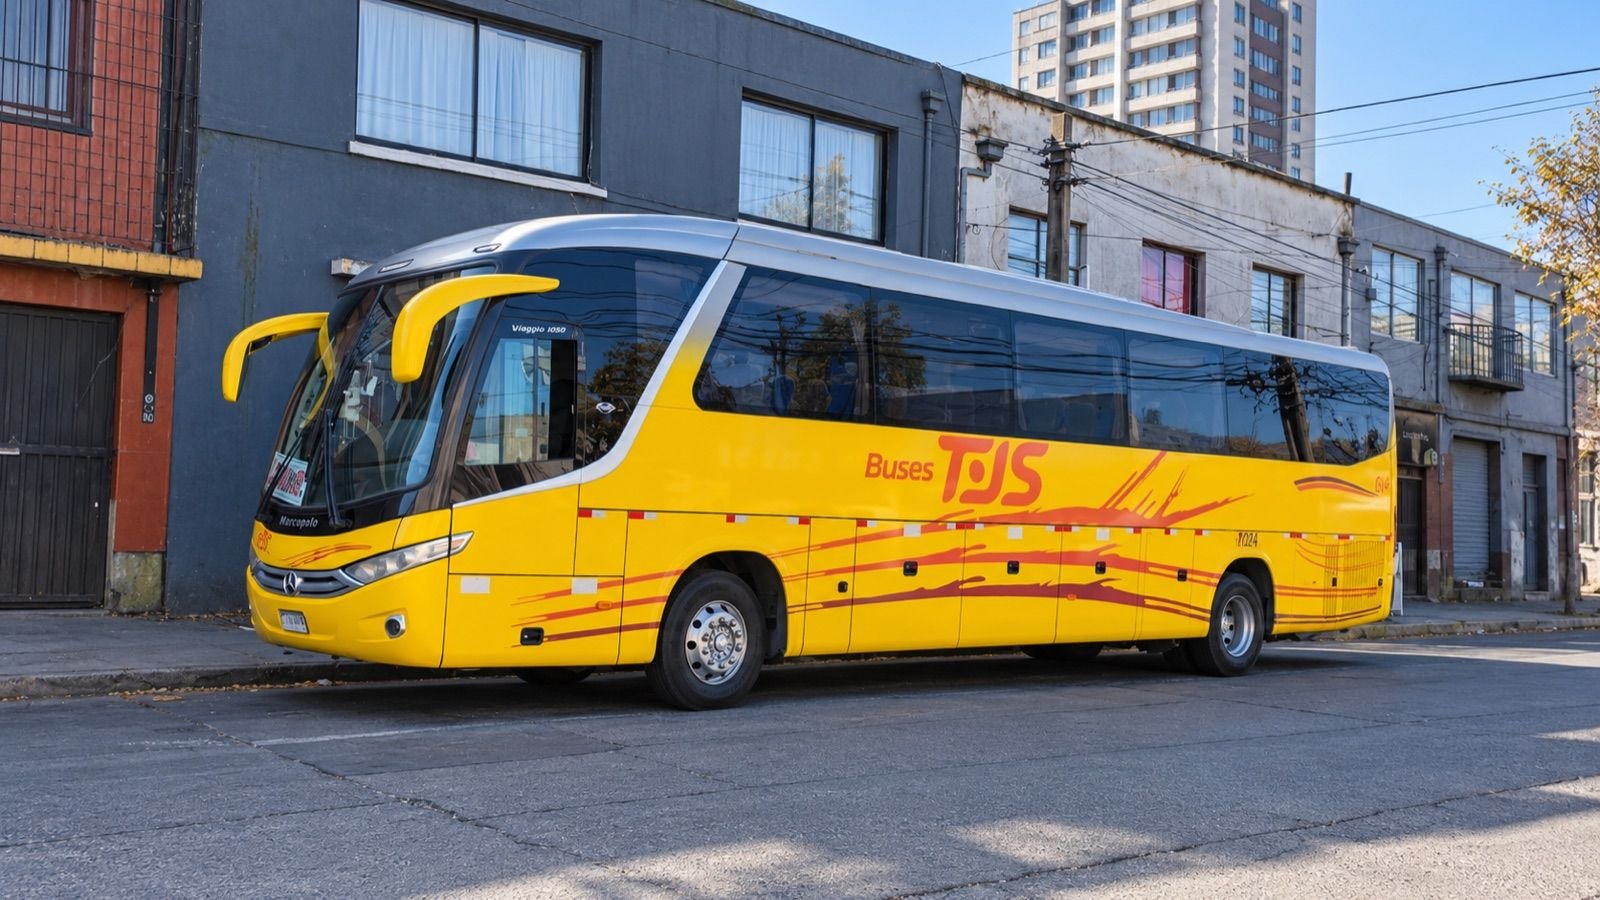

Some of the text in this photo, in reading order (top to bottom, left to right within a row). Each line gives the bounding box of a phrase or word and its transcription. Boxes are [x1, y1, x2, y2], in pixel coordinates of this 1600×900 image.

[512, 324, 545, 334] Viaggio
[865, 453, 934, 481] Buses
[280, 515, 318, 529] Marcopolo
